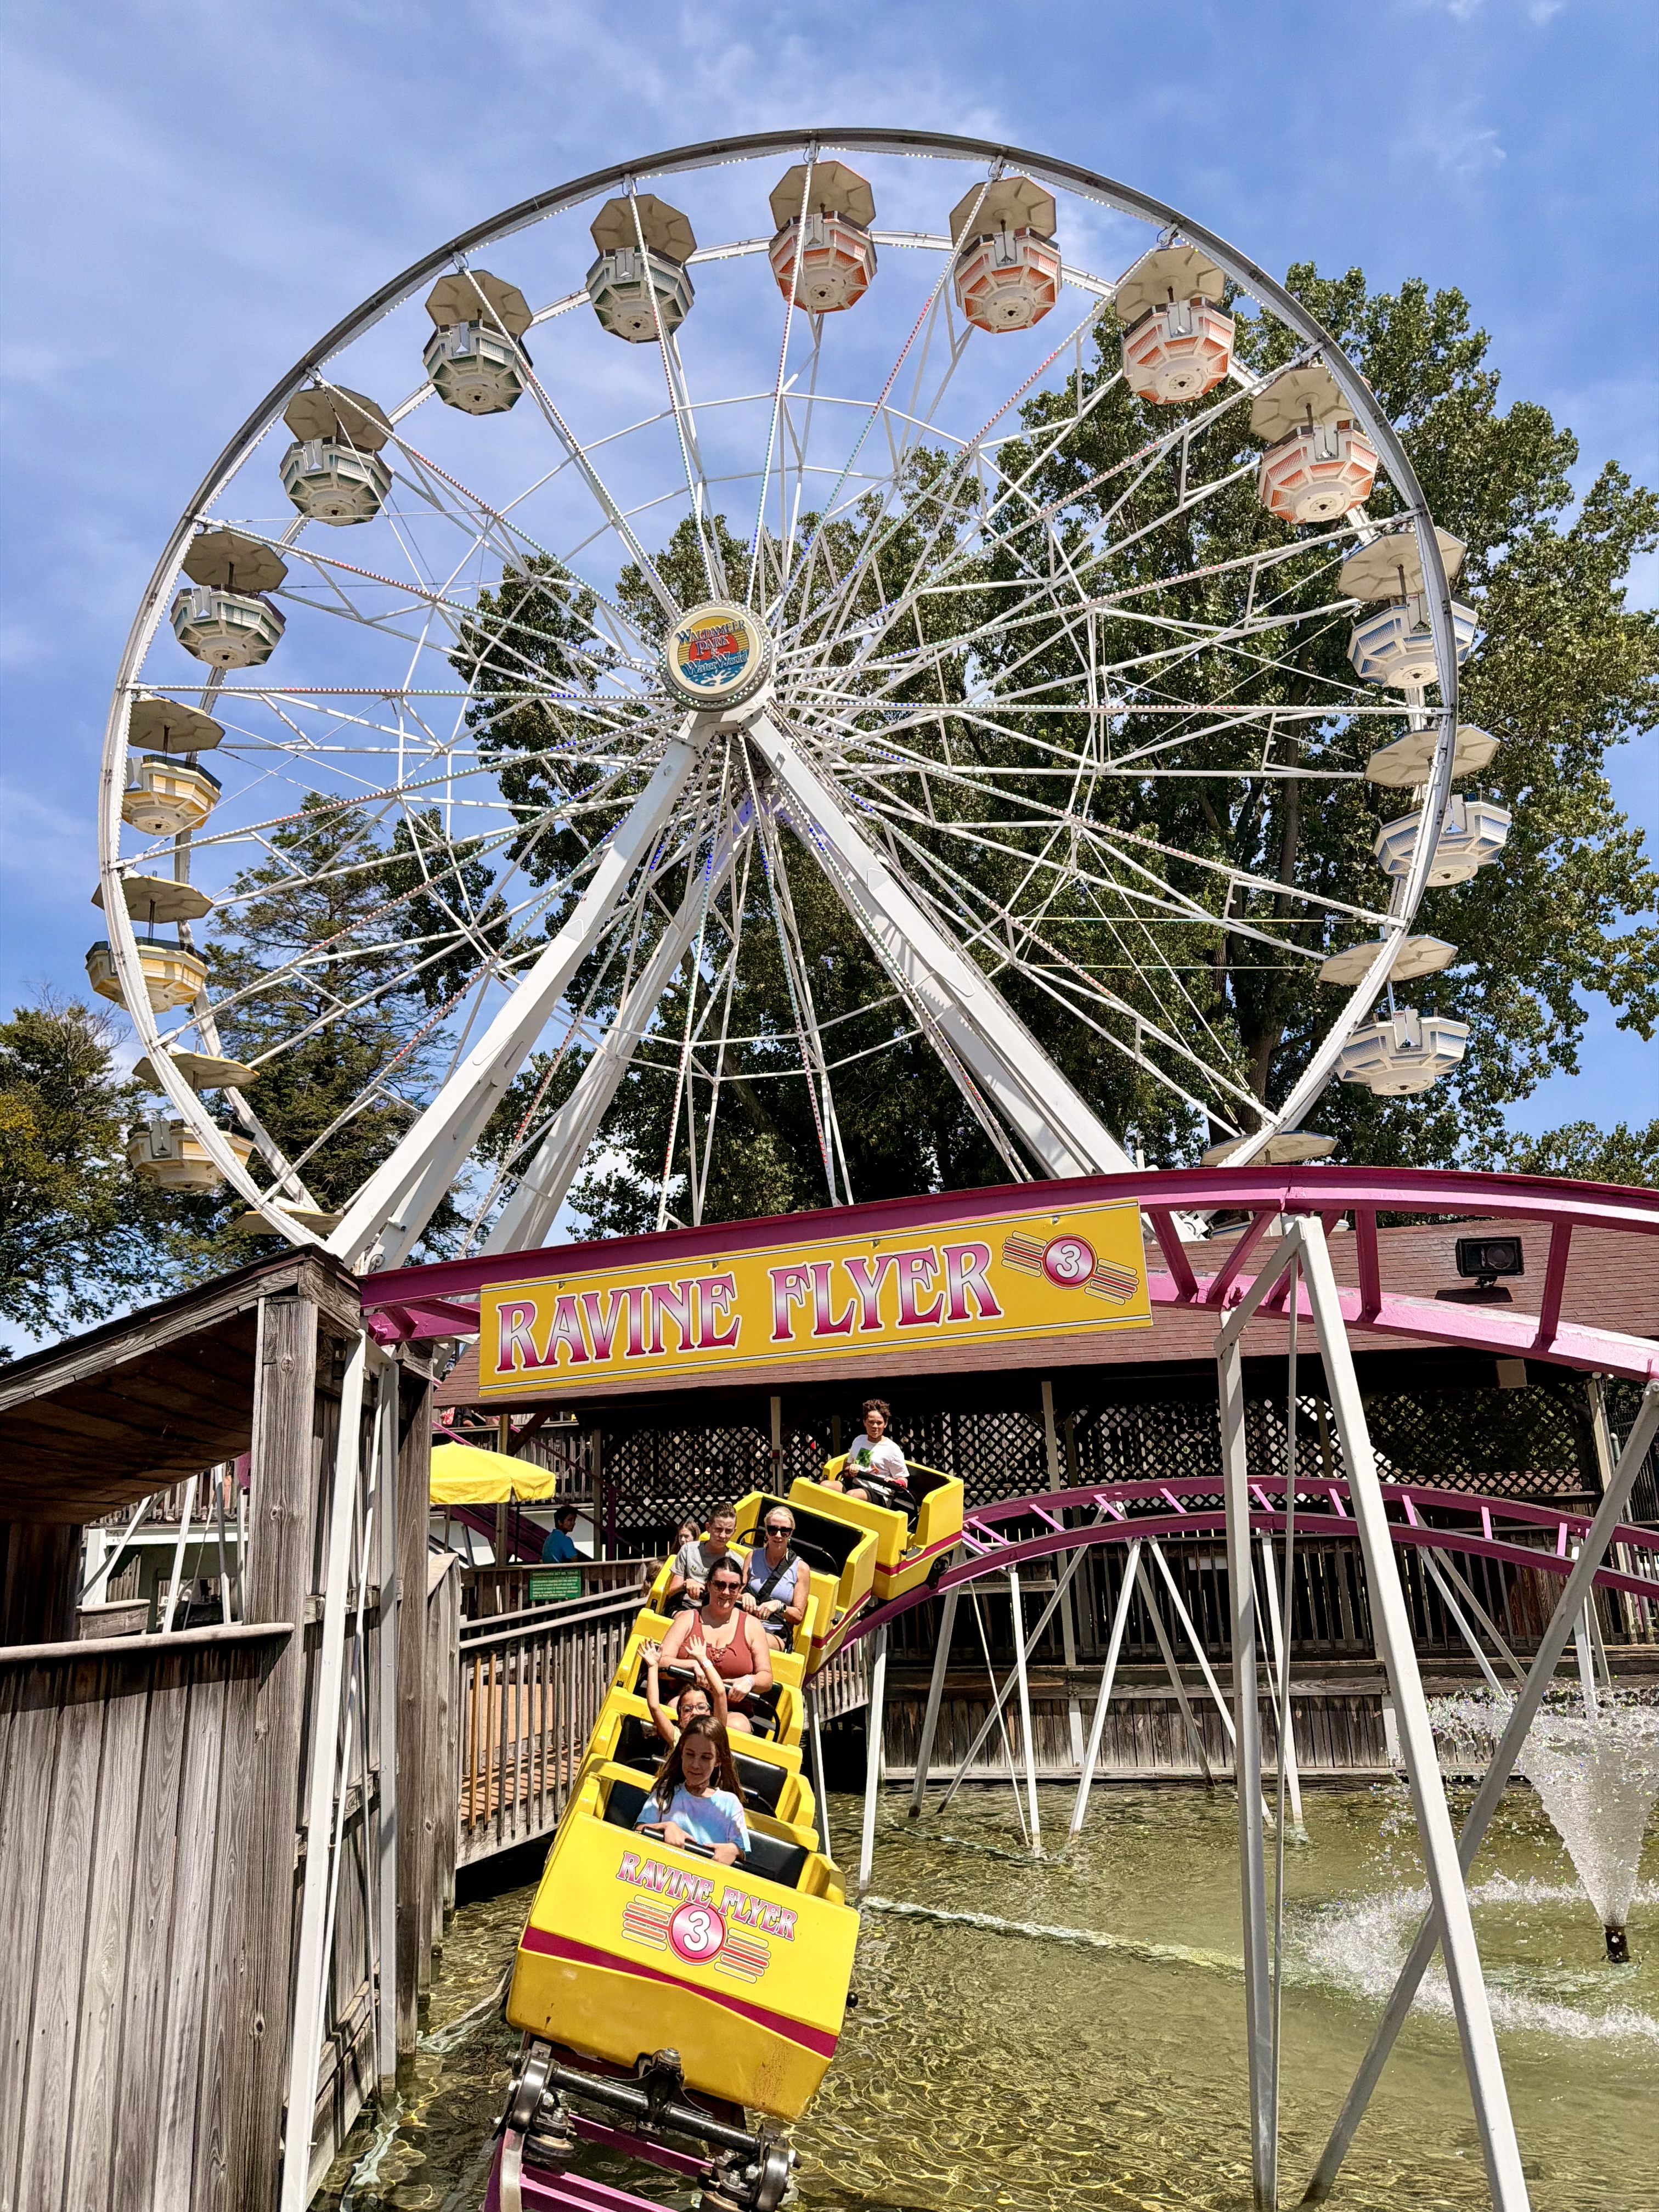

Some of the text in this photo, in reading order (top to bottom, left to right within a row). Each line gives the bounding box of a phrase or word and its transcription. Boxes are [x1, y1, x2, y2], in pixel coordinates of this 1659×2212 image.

[675, 618, 748, 644] WALDAMEER
[696, 634, 730, 656] PARK
[495, 1241, 1082, 1374] RAVINE FLYER 3
[616, 1850, 798, 1942] RAVINE FLYER
[683, 1910, 710, 1952] 3
